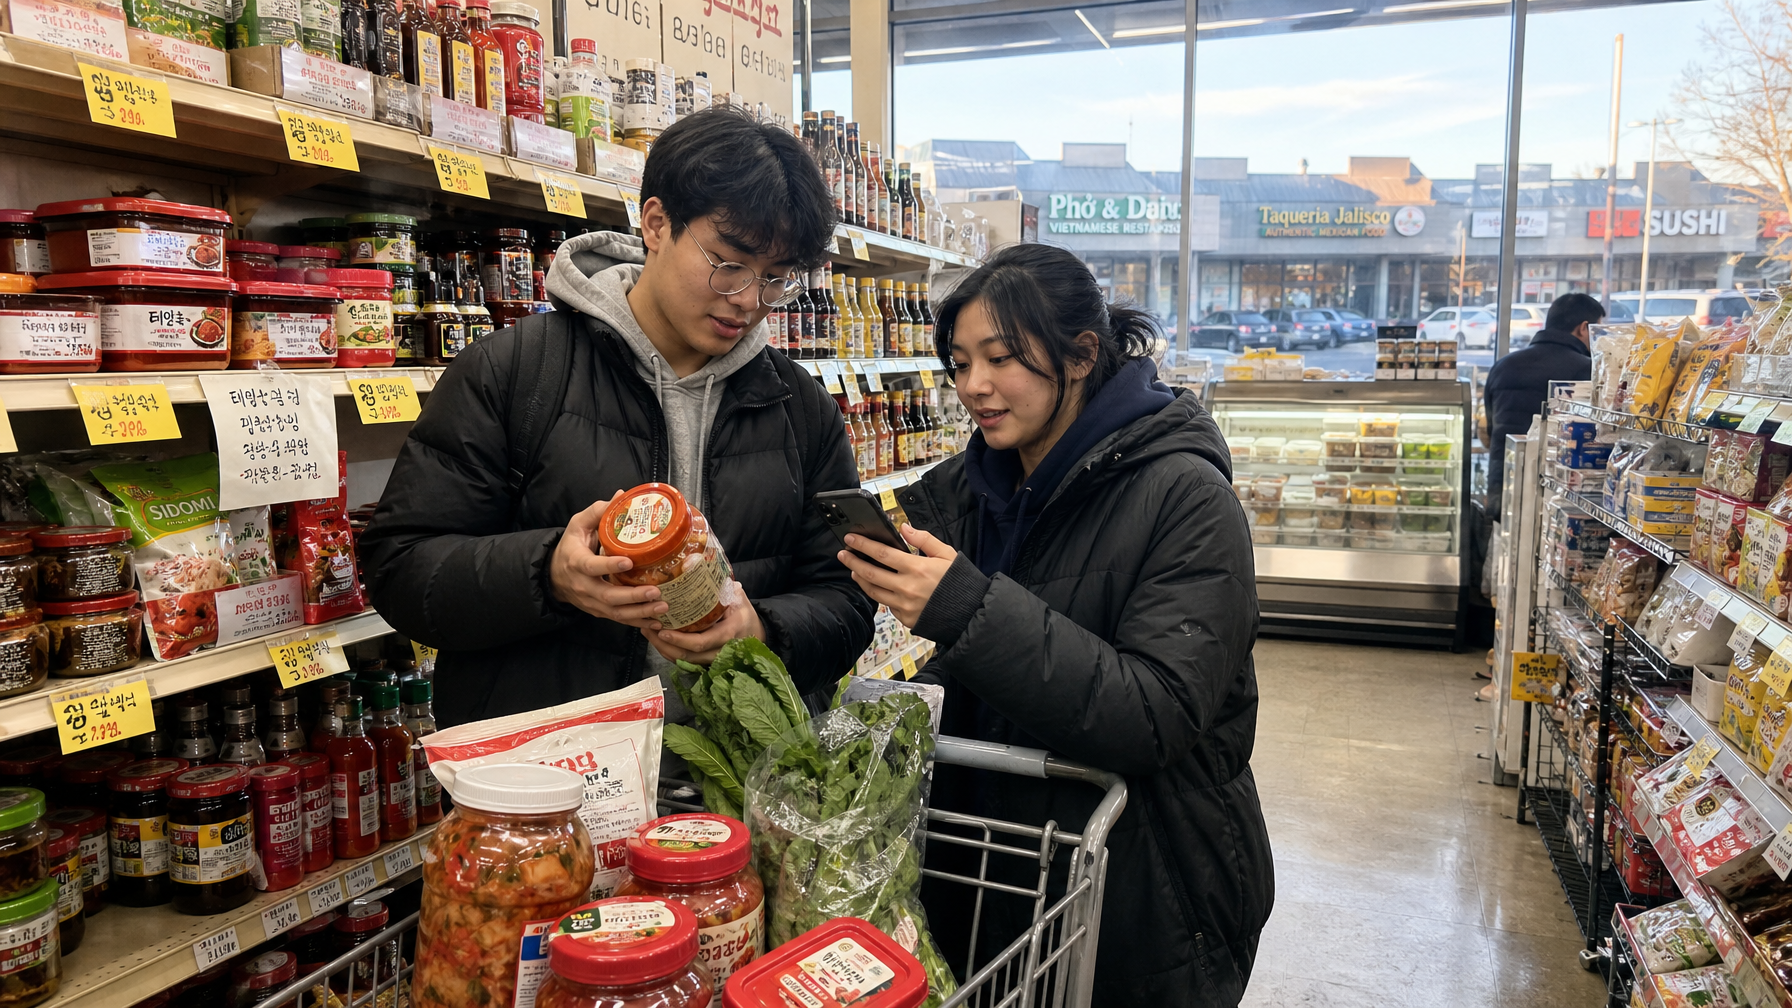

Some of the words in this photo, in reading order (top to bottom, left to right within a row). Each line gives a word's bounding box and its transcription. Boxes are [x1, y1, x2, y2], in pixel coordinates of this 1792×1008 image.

[1049, 193, 1097, 219] Phở
[1102, 198, 1120, 219] &
[1259, 206, 1330, 229] Taqueria
[1334, 206, 1391, 225] Jalisco
[1049, 222, 1119, 234] VIETNAMESE
[1265, 228, 1316, 237] AUTHENTIC
[1319, 228, 1358, 237] MEXICAN
[1646, 209, 1727, 236] SUSHI
[149, 496, 216, 520] SIDOMI
